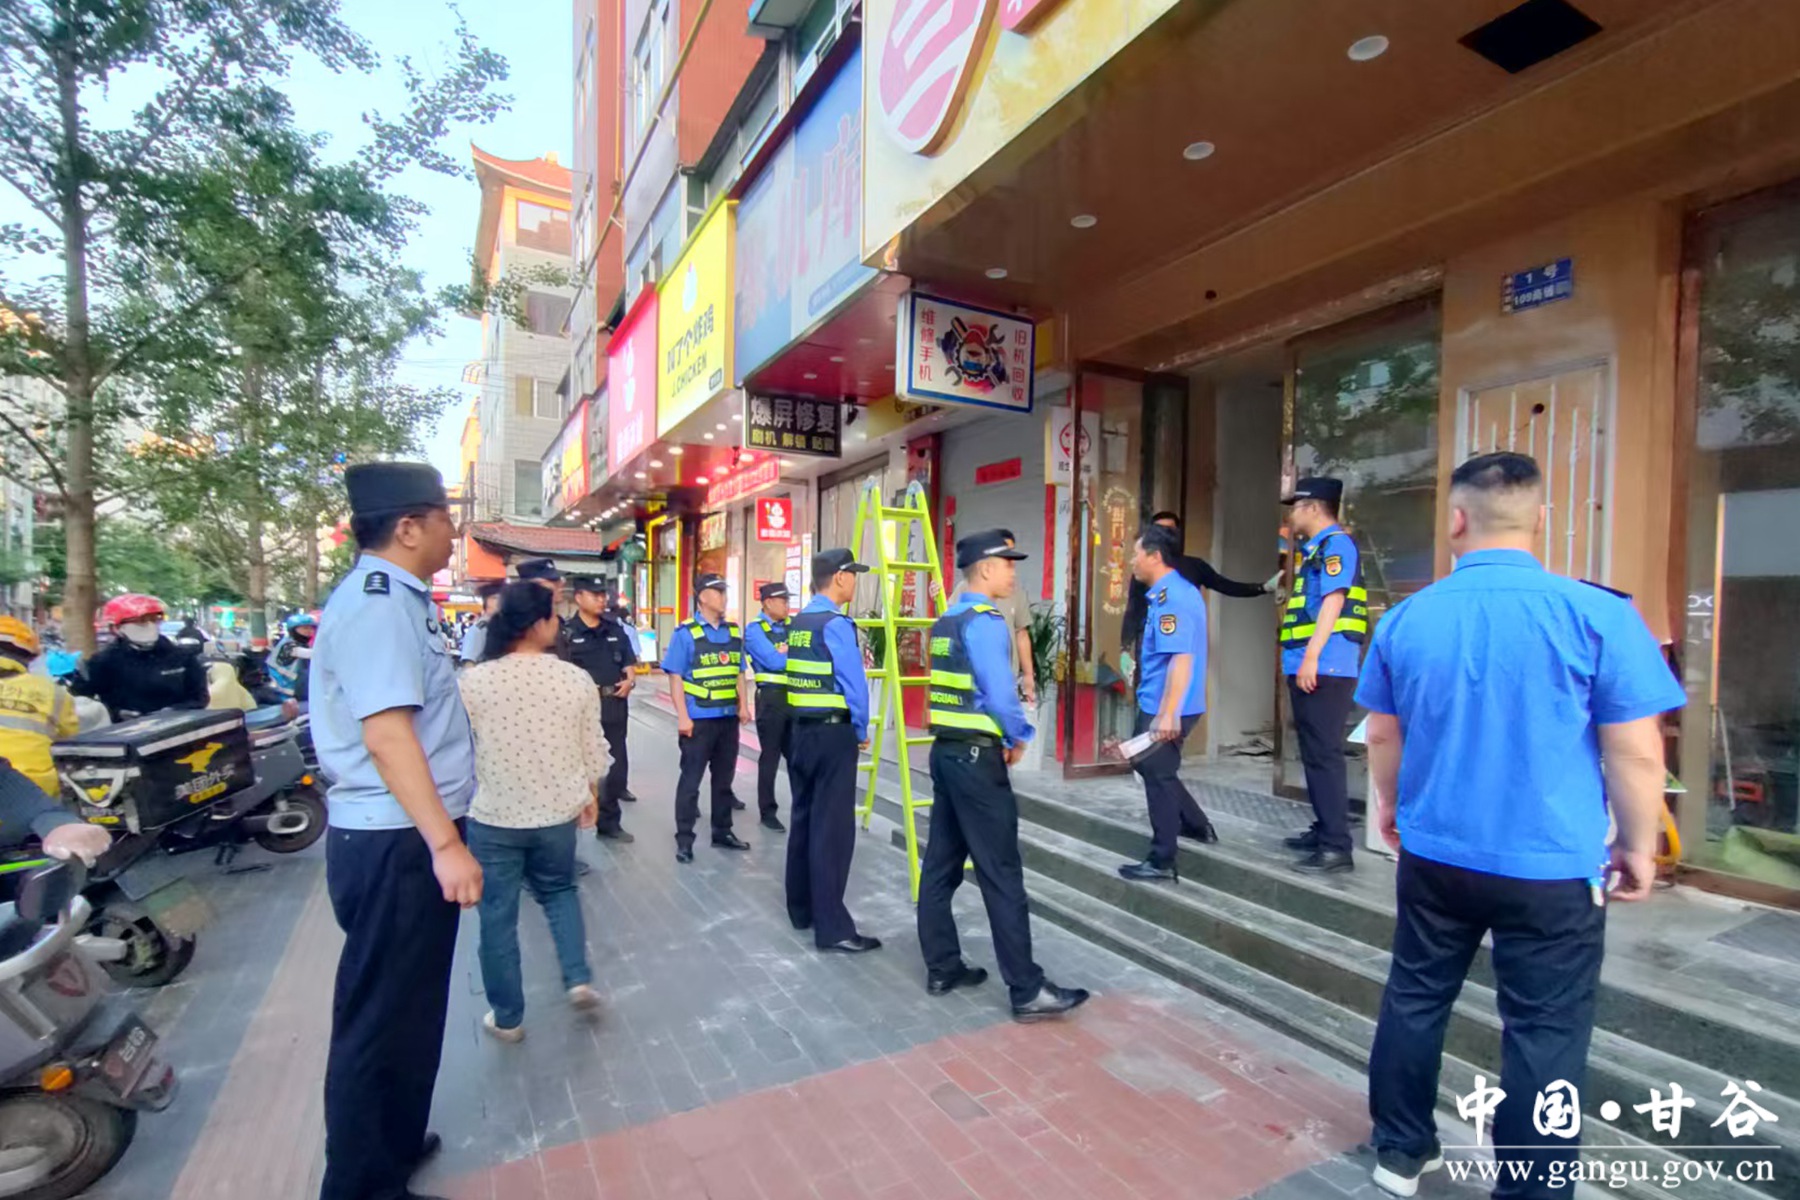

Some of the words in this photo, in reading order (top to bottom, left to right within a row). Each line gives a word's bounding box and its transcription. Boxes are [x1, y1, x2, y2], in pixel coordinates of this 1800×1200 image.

[919, 307, 936, 382] 维修手机
[1012, 328, 1027, 402] 旧机回收
[751, 395, 835, 434] 爆屏修复
